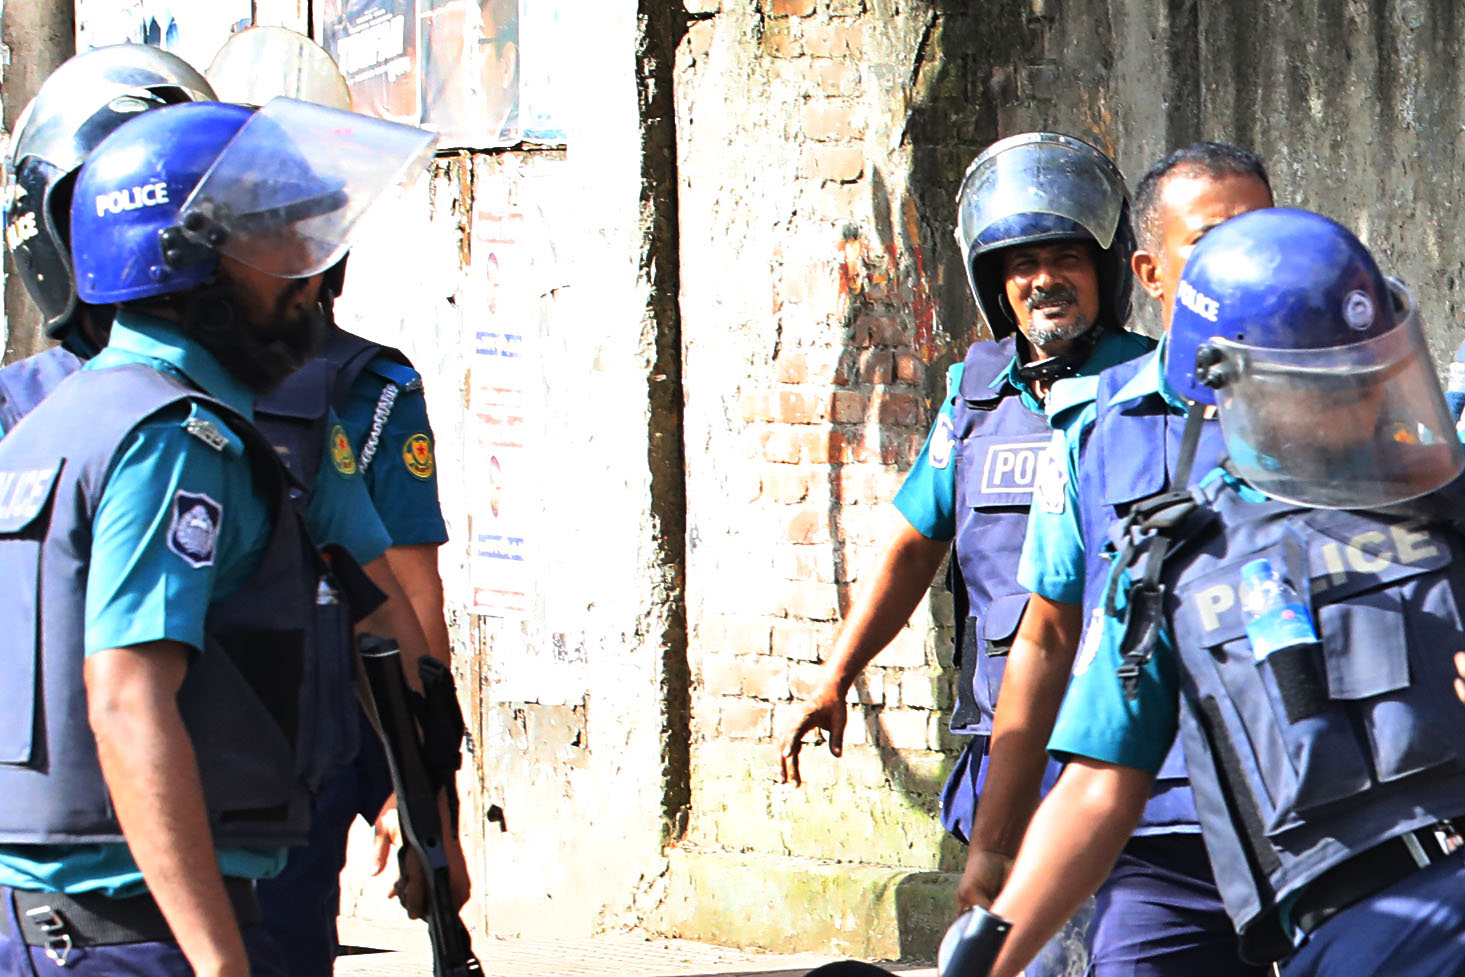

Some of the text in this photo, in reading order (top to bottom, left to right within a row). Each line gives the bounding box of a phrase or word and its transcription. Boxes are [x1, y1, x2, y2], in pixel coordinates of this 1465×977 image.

[96, 182, 169, 217] POLICE
[993, 450, 1046, 486] PO
[1194, 526, 1438, 632] PICE
